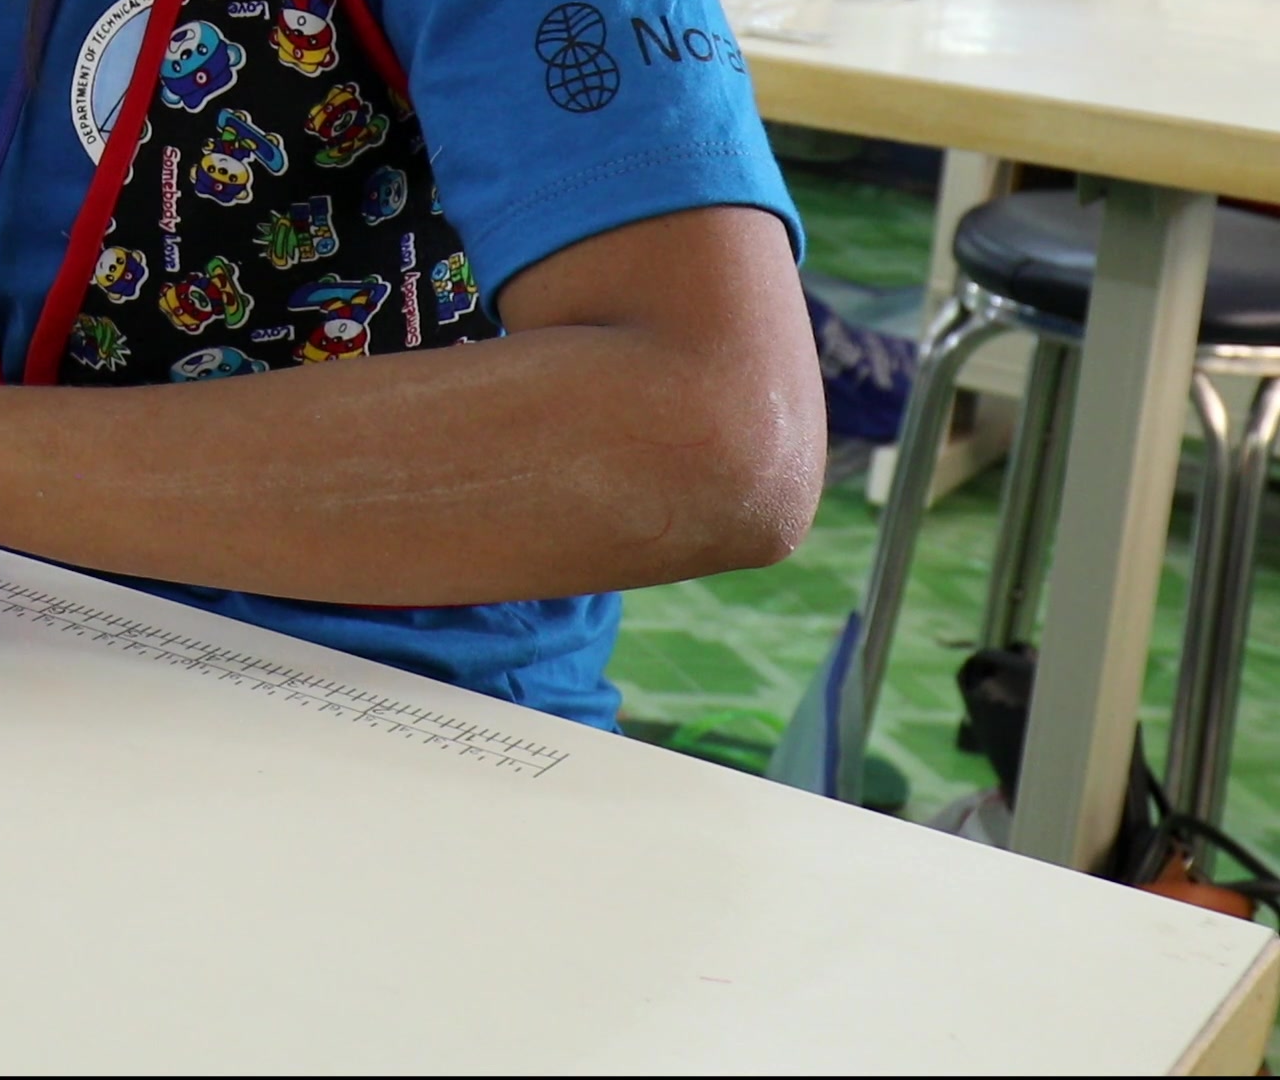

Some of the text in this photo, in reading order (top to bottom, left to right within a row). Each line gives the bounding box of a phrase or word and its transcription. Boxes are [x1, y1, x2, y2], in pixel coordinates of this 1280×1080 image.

[85, 47, 98, 63] OF
[76, 65, 97, 145] DEPARTMENT
[159, 146, 181, 272] Somebody Love
[400, 271, 421, 347] Somebody
